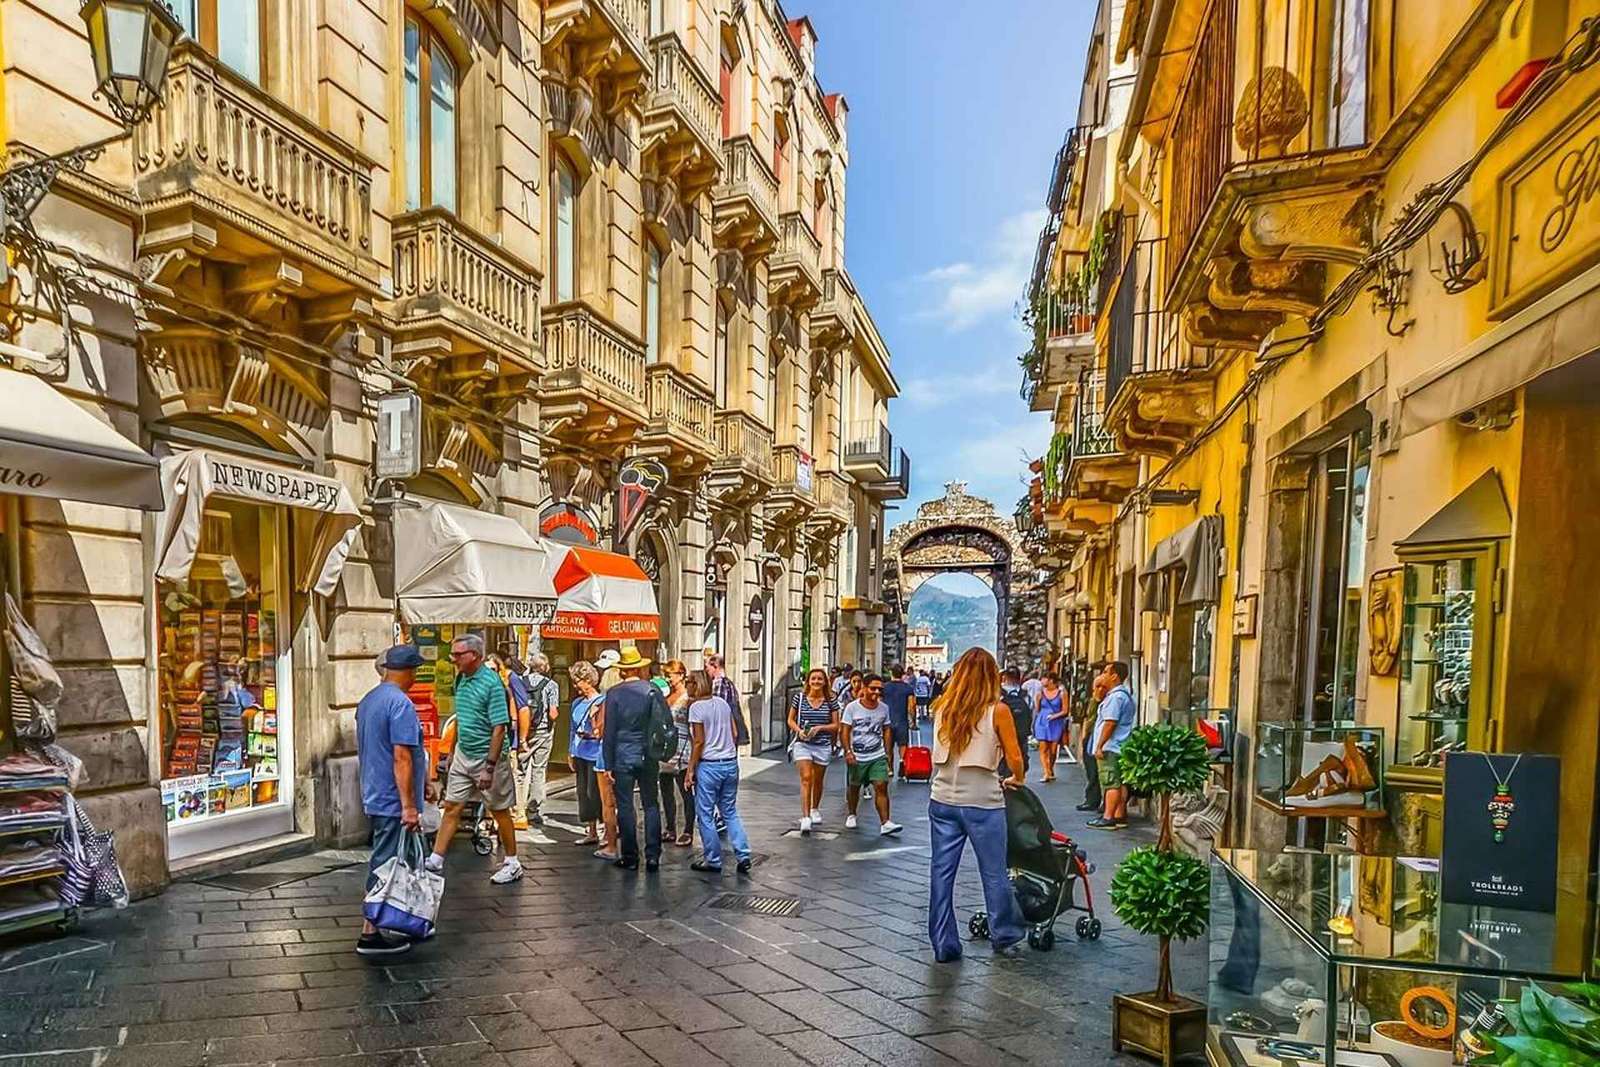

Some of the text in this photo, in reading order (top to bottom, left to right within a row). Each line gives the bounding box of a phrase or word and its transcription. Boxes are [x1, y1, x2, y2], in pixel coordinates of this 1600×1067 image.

[212, 462, 340, 507] NEWSPAPER
[556, 617, 586, 625] GELATO
[608, 620, 657, 633] GELATOMANIA
[545, 625, 593, 635] ARTIGIANALE
[1471, 881, 1523, 892] TROLLBEADS
